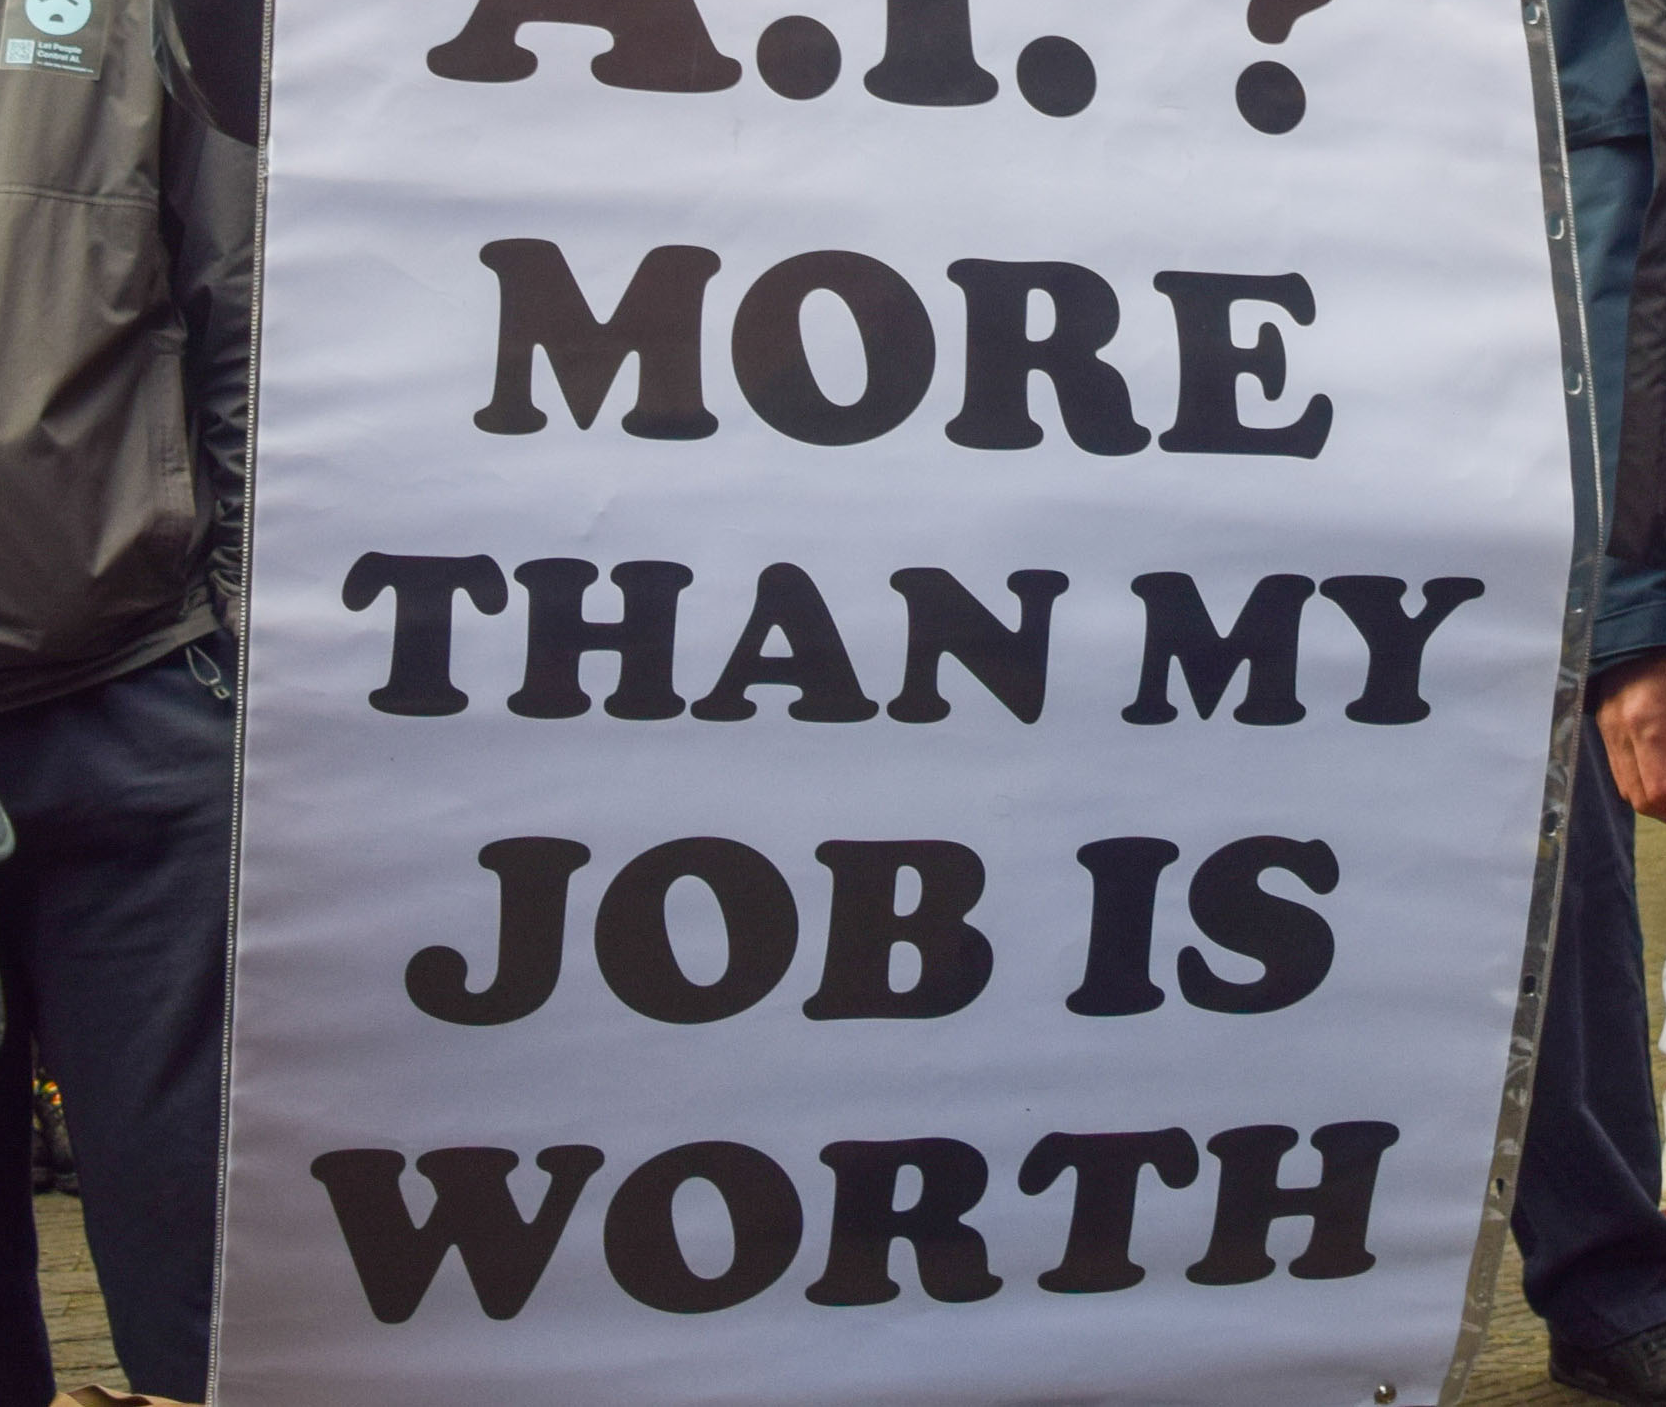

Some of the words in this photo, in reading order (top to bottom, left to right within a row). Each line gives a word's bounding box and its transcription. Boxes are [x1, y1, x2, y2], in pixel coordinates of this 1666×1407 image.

[474, 239, 1333, 460] MORE
[343, 552, 1069, 725] THAN
[1121, 572, 1485, 727] MY
[405, 837, 994, 1027] JOB
[1066, 836, 1340, 1018] IS
[310, 1121, 1400, 1325] WORTH
